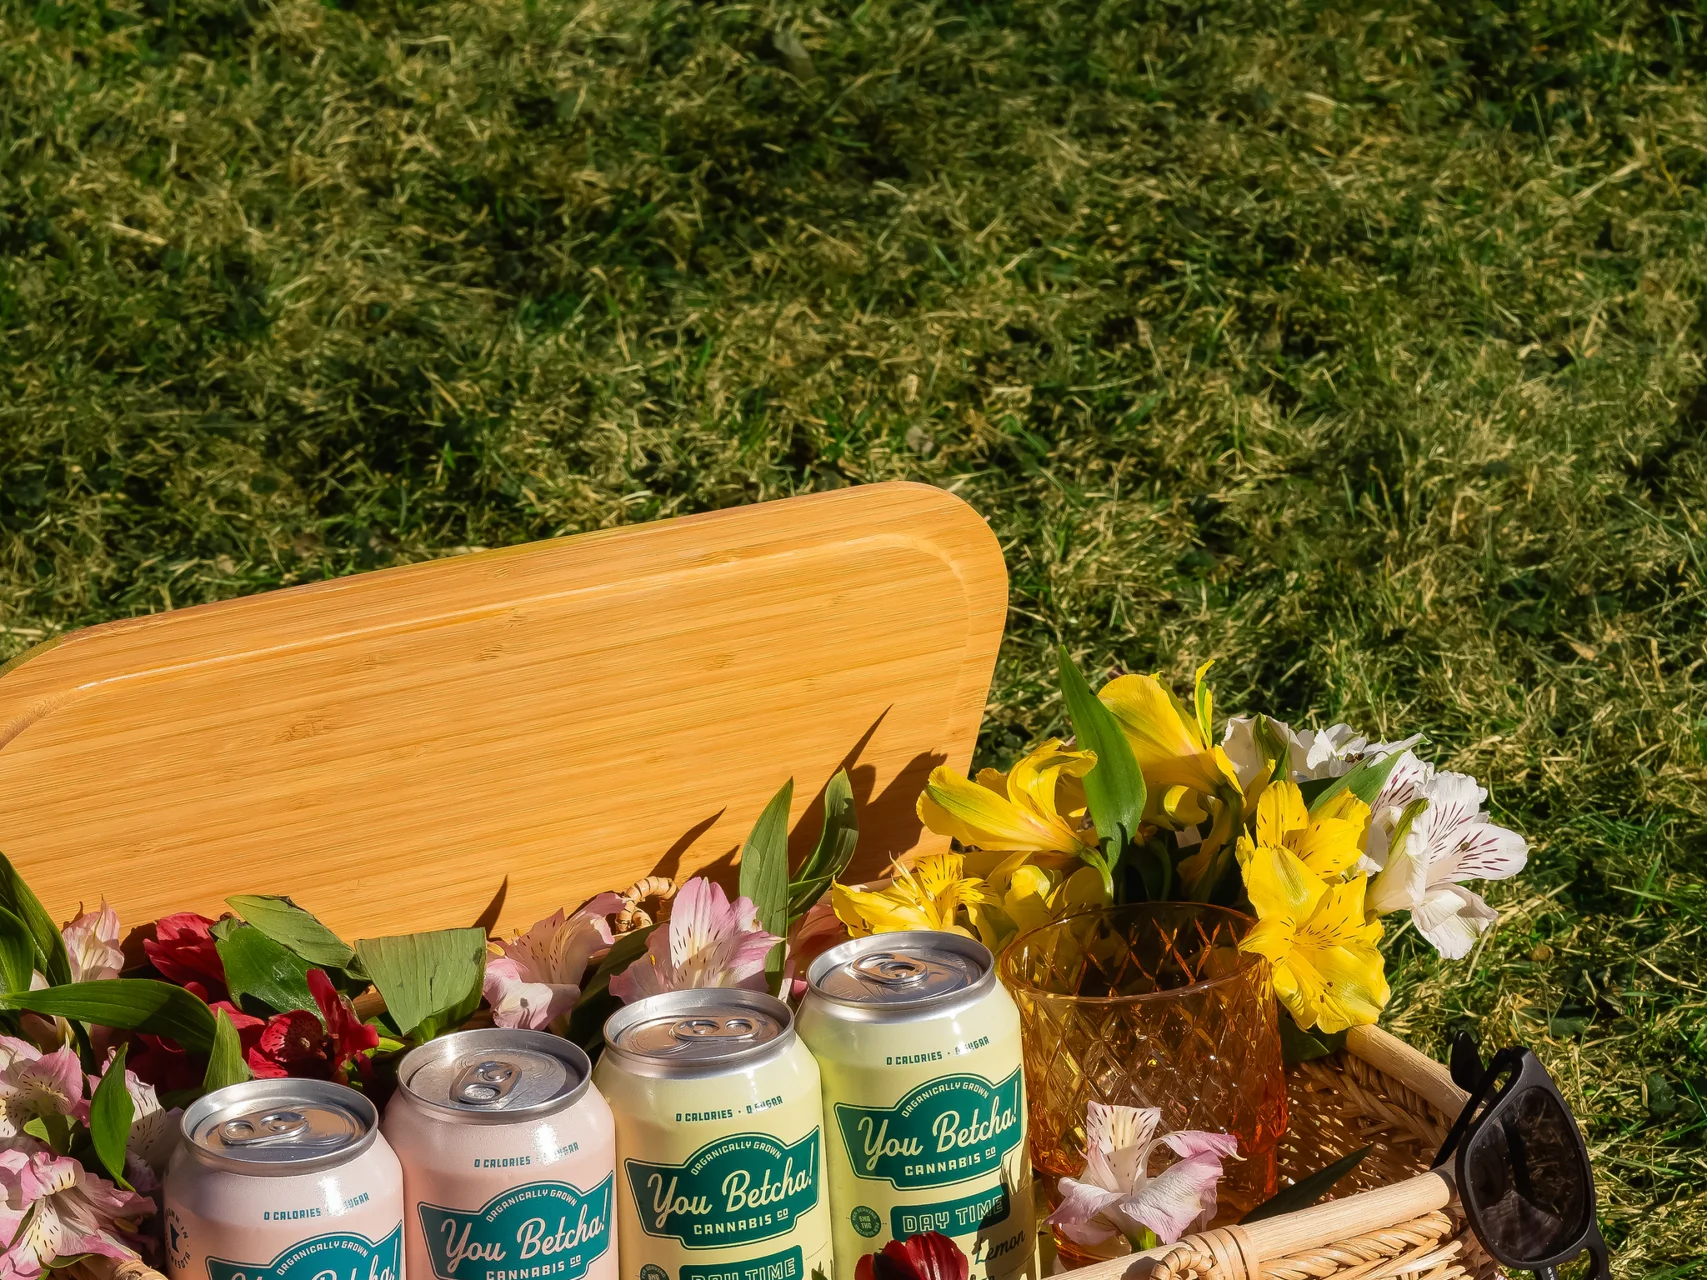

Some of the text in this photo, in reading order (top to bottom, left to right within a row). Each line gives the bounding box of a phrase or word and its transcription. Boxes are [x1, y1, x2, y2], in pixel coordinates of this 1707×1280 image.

[895, 1051, 943, 1065] CALORIES
[965, 1036, 990, 1050] UGAR
[685, 1109, 733, 1122] CALORIES
[901, 1082, 989, 1118] ORGANICALLY GROWN
[857, 1080, 1018, 1171] You Betcha!
[483, 1156, 531, 1168] CALORIES
[690, 1141, 782, 1176] ORGANICALLY GROWN
[904, 1146, 996, 1176] CANNABIS CO
[647, 1142, 815, 1228] You Betcha!
[273, 1207, 321, 1220] CALORIES
[485, 1189, 577, 1223] ORGANICALLY GROWN
[694, 1207, 788, 1235] CANNABIS CO
[902, 1195, 1004, 1233] DAY TIME
[440, 1188, 608, 1273] You Betcha!
[975, 1230, 1025, 1265] Lemon
[277, 1240, 369, 1275] ORGANICALLY GROWN
[486, 1255, 581, 1280] CANNABIS CO
